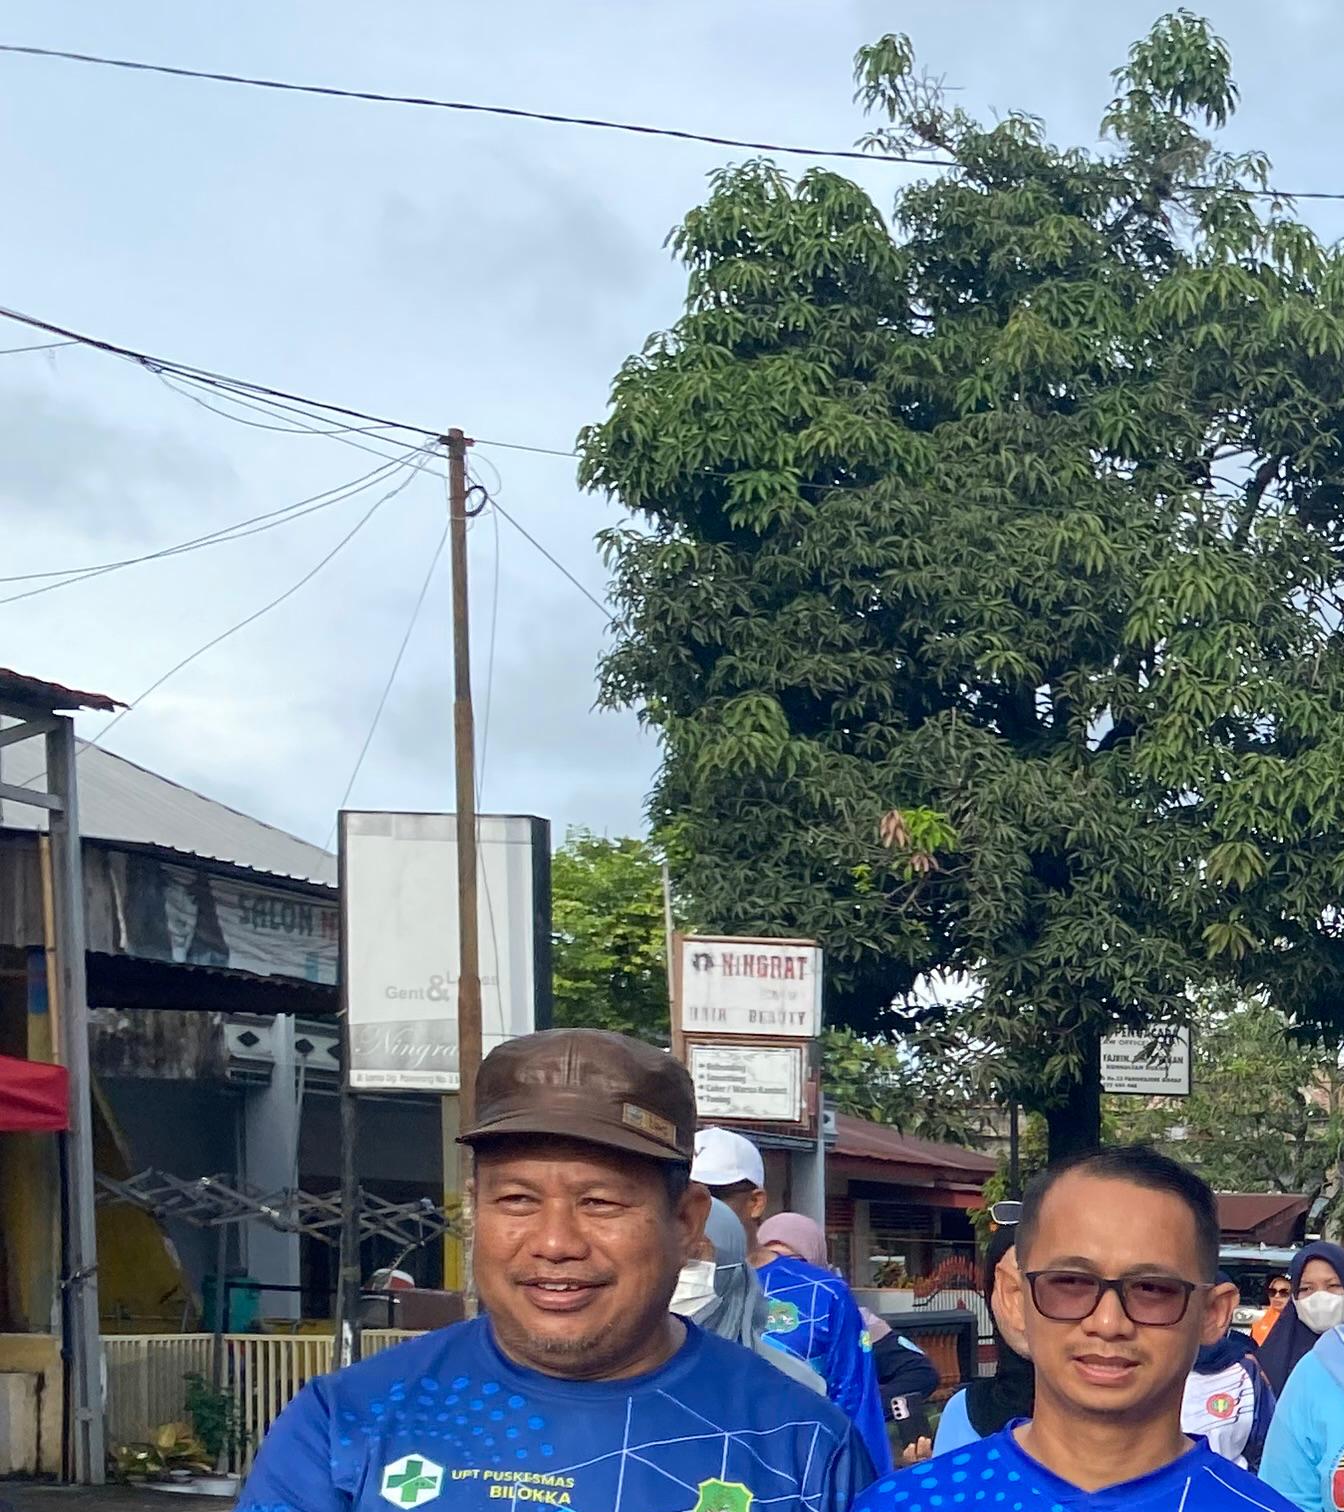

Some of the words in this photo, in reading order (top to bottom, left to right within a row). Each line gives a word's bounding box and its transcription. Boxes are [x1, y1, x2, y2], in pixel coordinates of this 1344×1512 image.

[721, 953, 808, 981] NINGRAT
[385, 985, 425, 1000] Gent
[483, 1469, 575, 1489] PUSKESMAS
[489, 1485, 572, 1505] BILOKKA
